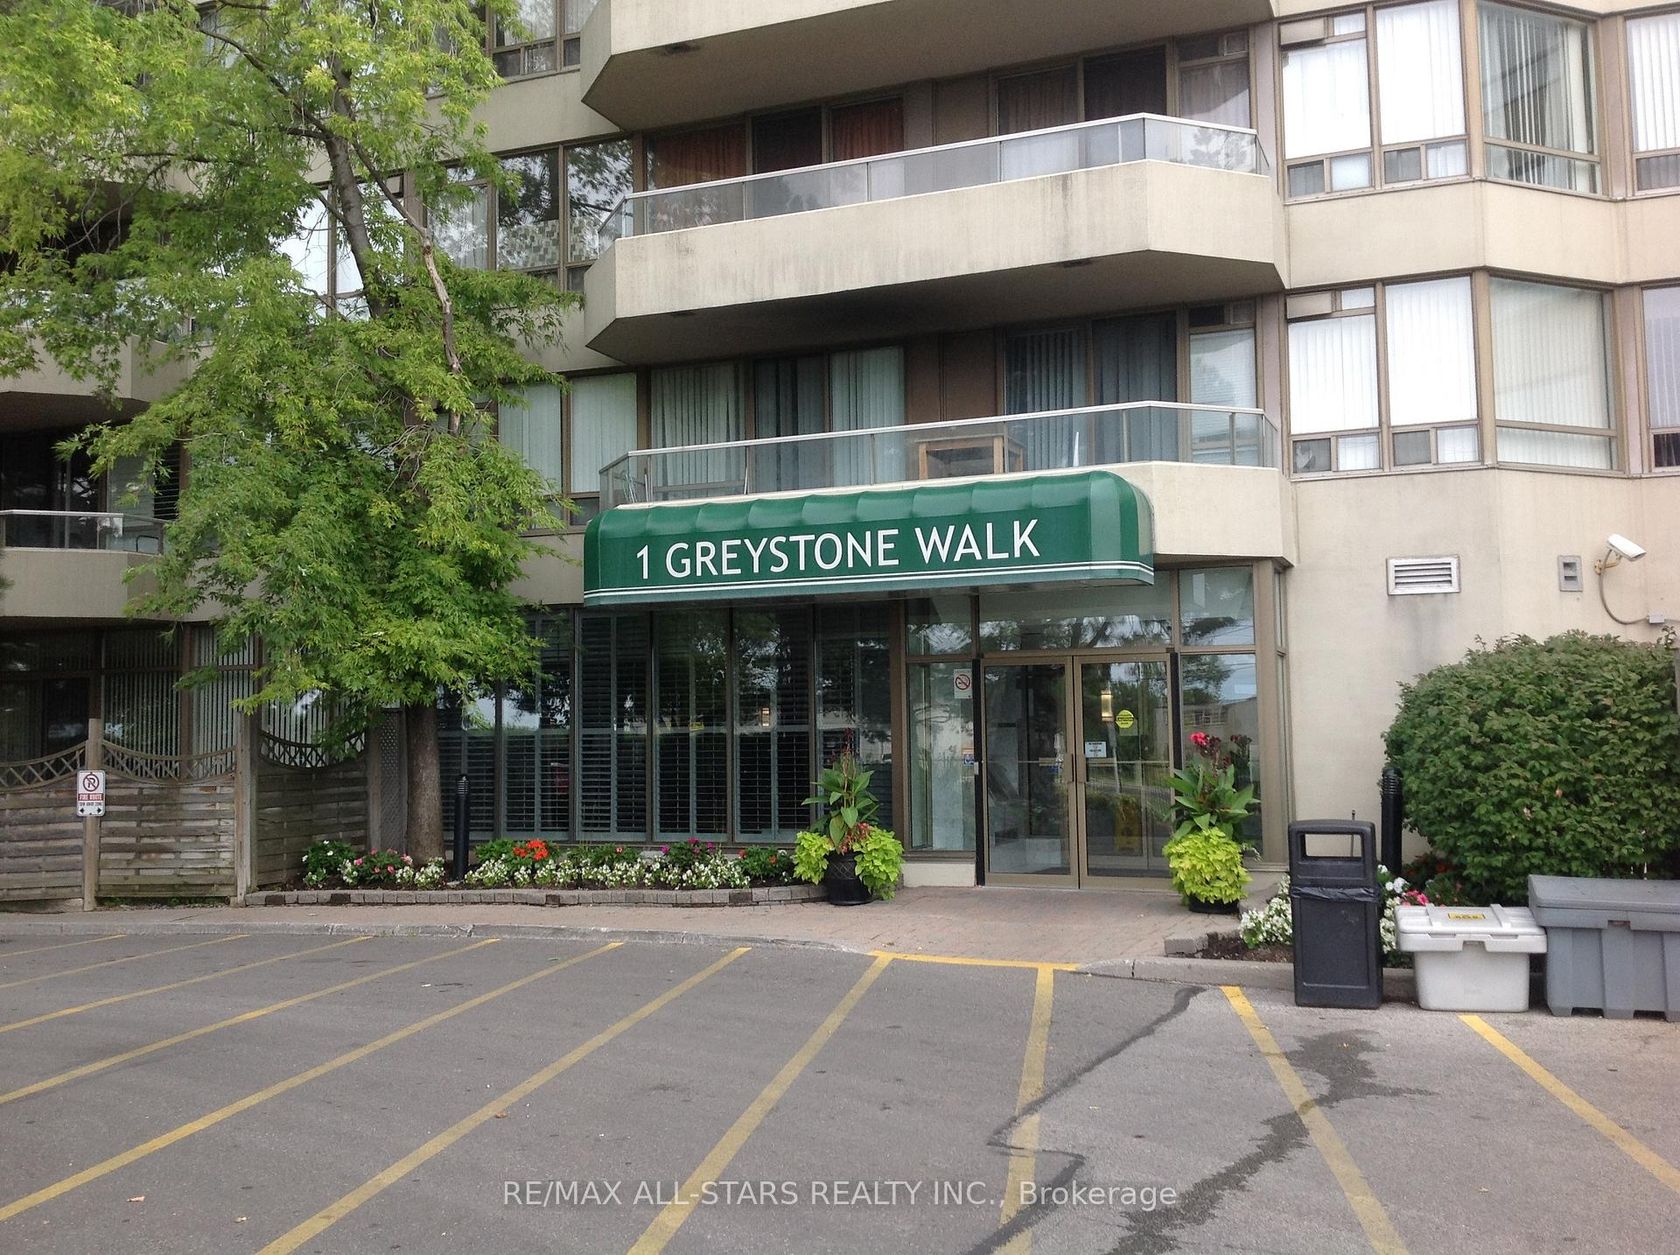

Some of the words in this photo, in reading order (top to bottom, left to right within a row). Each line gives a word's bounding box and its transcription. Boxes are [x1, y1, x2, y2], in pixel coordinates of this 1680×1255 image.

[636, 544, 649, 580] 1
[665, 528, 899, 579] GREYSTONE
[914, 518, 1041, 564] WALK
